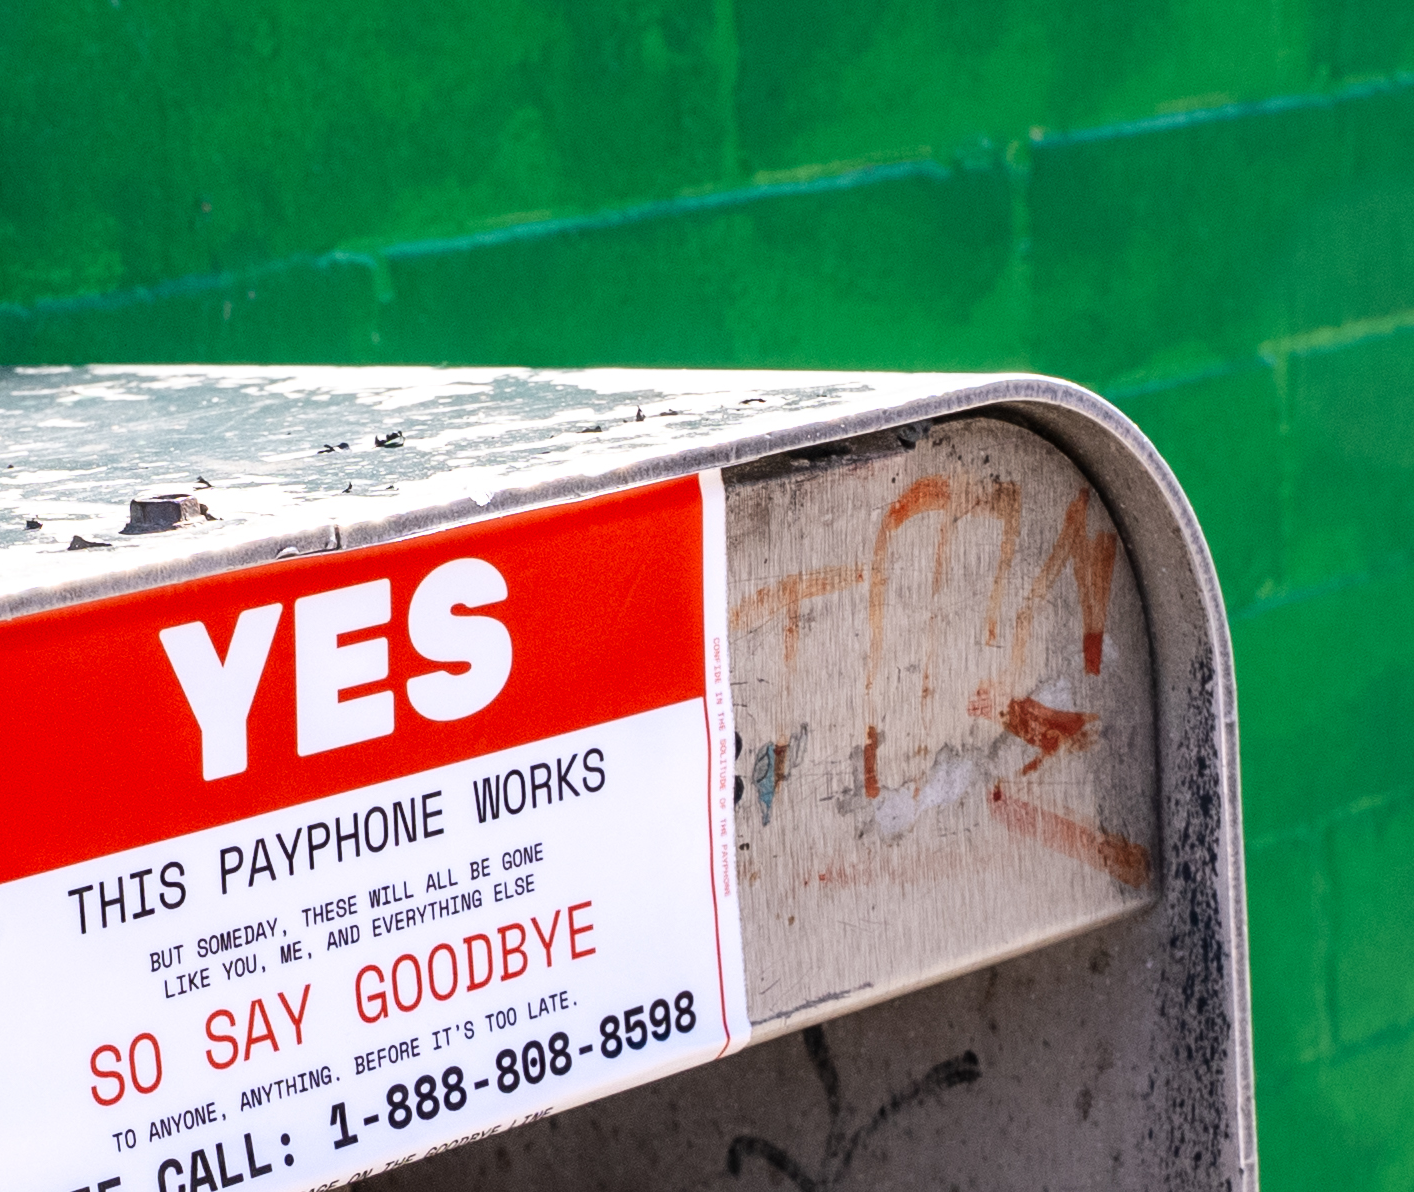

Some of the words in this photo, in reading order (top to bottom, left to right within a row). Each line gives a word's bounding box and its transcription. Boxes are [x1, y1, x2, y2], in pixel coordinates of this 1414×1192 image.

[159, 557, 513, 782] YES
[712, 637, 722, 684] CONFIDE
[715, 691, 723, 705] IN
[717, 712, 726, 732] THE
[719, 738, 728, 791] SOLITUDE
[719, 798, 726, 809] OF
[67, 861, 187, 935] THIS
[219, 790, 445, 896] PAYPHONE
[473, 748, 606, 824] WORKS
[720, 818, 728, 837] THE
[149, 945, 184, 973] BUT
[196, 918, 288, 958] SOMEDAY,
[301, 895, 358, 928] THESE
[368, 881, 414, 909] WILL
[425, 868, 458, 893] ALL
[470, 857, 491, 881] BE
[501, 842, 544, 871] GONE
[721, 843, 731, 897] PAYPHONE
[163, 966, 211, 999] LIKE
[222, 953, 267, 982] YOU,
[280, 940, 313, 966] ME,
[327, 924, 360, 951] AND
[372, 889, 483, 938] EVERYTHING
[493, 874, 535, 902] ELSE
[90, 1032, 163, 1107] SO
[204, 983, 312, 1070] SAY
[354, 900, 597, 1024] GOODBYE
[112, 1128, 137, 1153] TO
[149, 1102, 227, 1142] ANYONE,
[239, 1066, 341, 1112] ANYTHING.
[354, 1038, 422, 1075] BEFORE
[433, 1020, 475, 1051] IT'S
[485, 1007, 518, 1034] TOO
[528, 990, 578, 1020] LATE.
[329, 990, 698, 1151] 1-888-808-8598
[346, 1168, 374, 1184] ON
[382, 1153, 418, 1172] THE
[423, 1125, 502, 1157] GOODBYE
[510, 1106, 555, 1128] LINE
